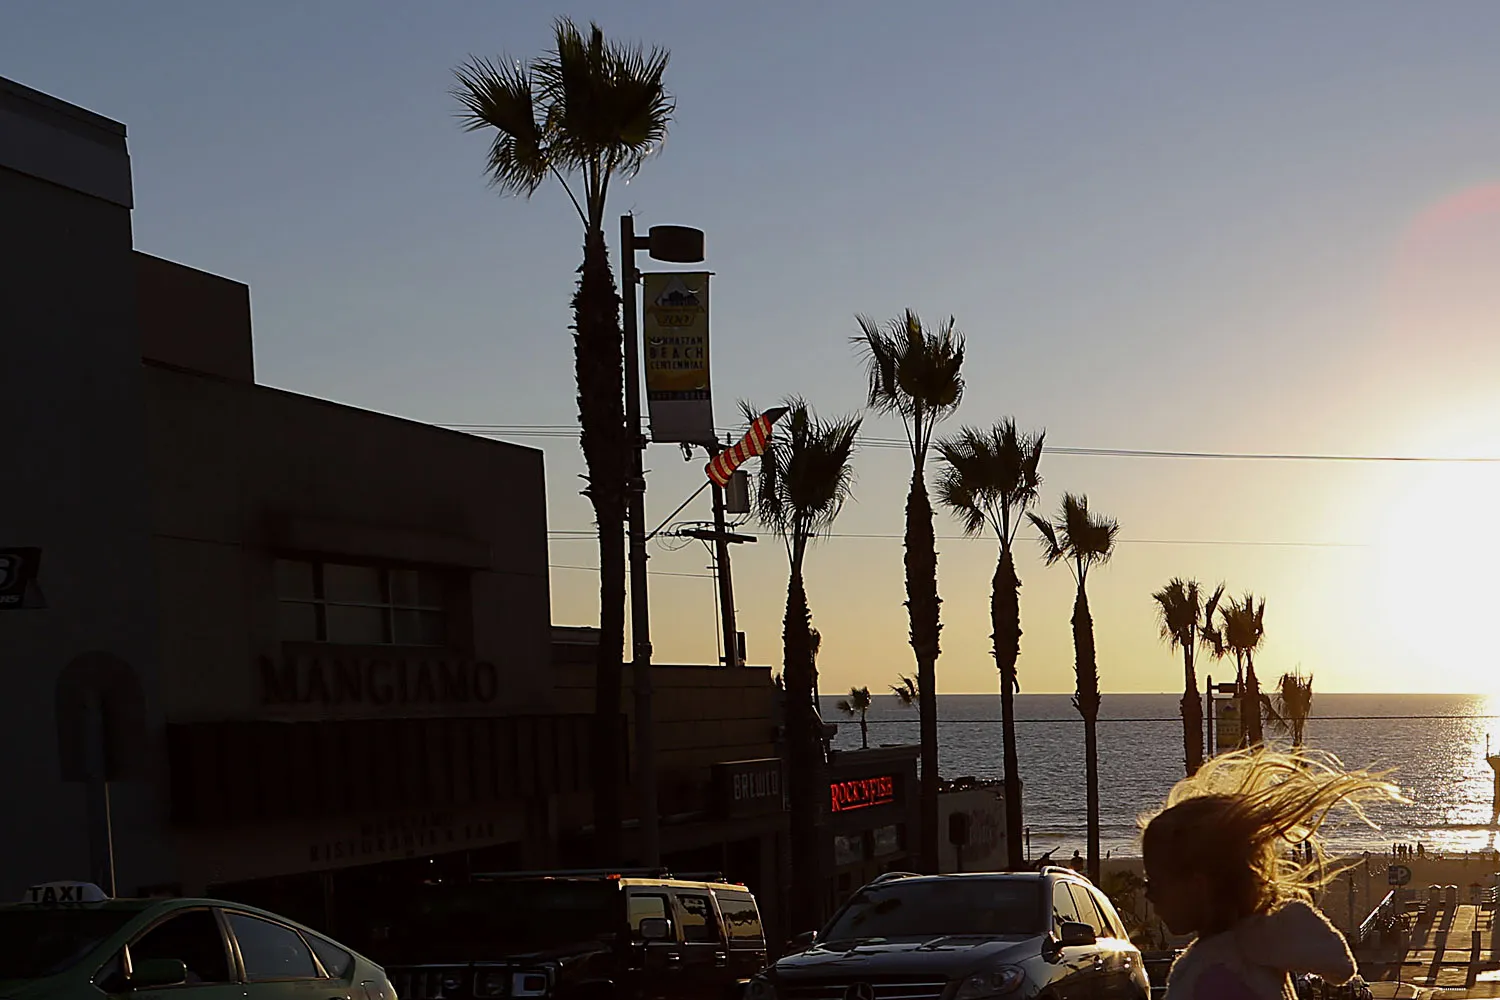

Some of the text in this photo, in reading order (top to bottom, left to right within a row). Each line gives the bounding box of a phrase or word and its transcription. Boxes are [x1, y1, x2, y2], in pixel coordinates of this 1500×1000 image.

[649, 347, 704, 359] BEACH
[257, 655, 499, 705] MANGIAMO
[28, 886, 83, 905] TAXI
